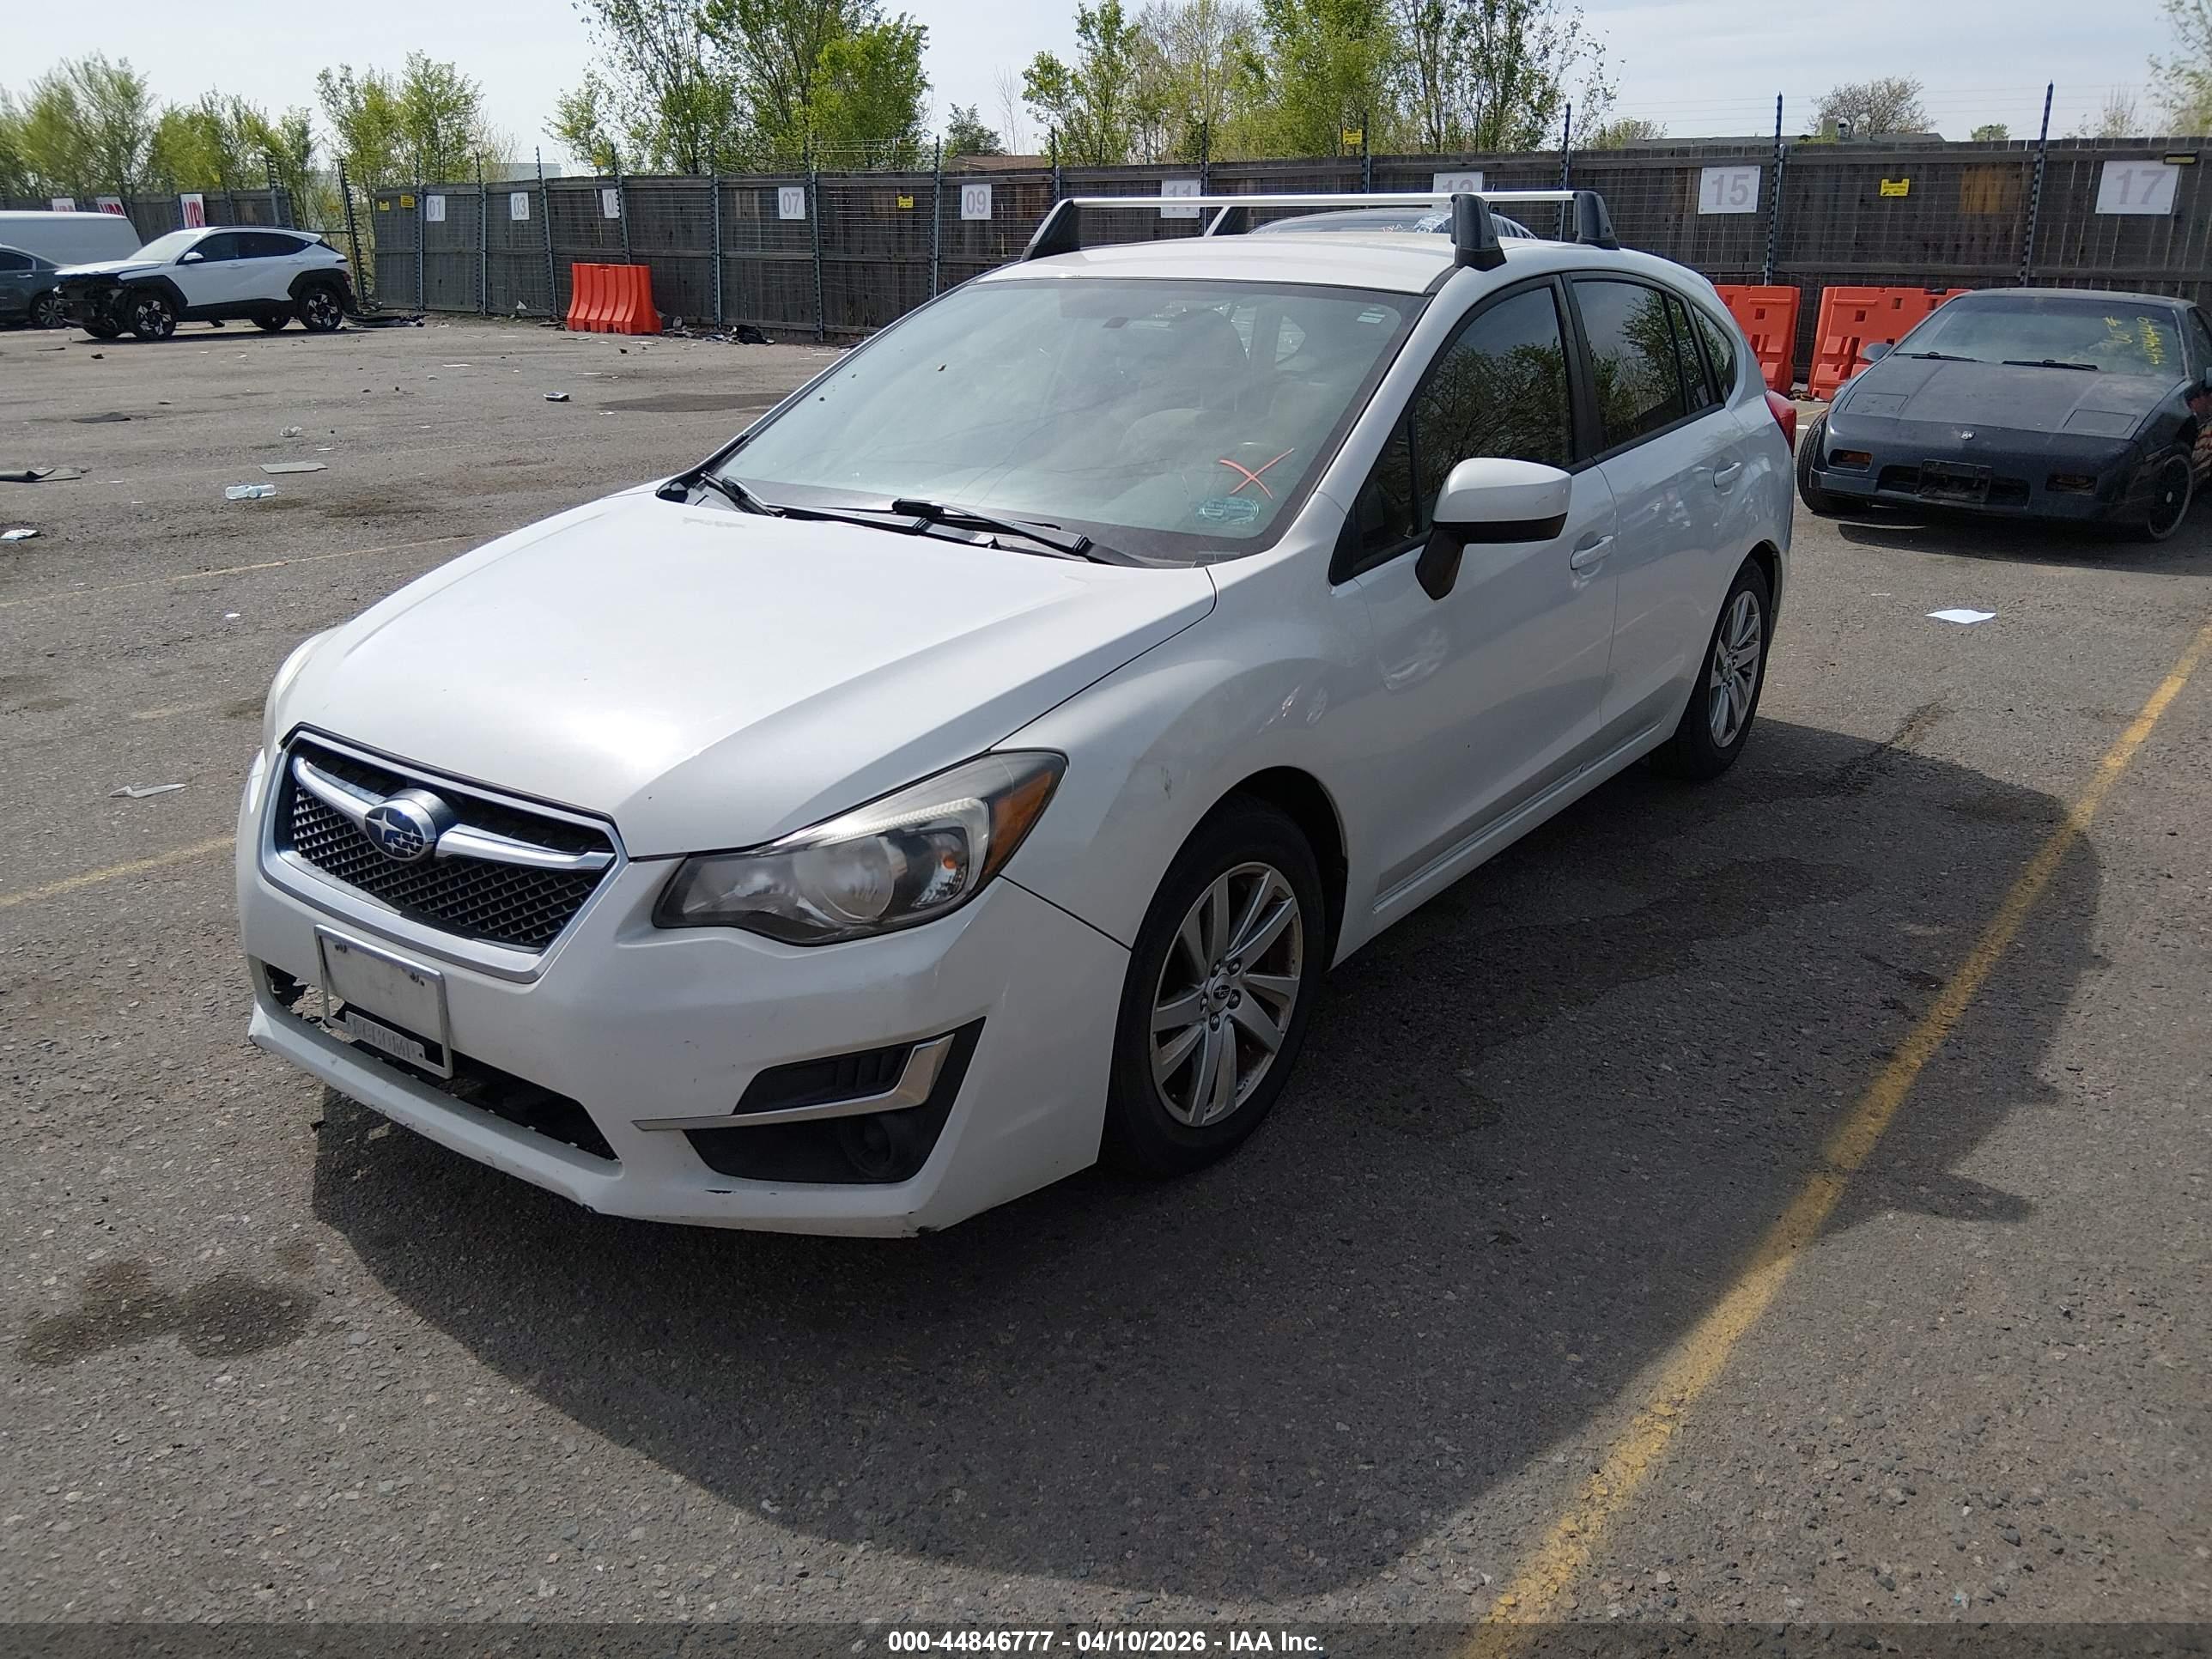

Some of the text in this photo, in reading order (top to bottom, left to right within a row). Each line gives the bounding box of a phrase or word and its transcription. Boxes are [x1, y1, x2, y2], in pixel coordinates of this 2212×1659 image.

[1711, 174, 1750, 206] 15
[2116, 168, 2167, 205] 17
[429, 198, 441, 217] 01
[514, 197, 526, 215] 03
[782, 191, 800, 214] 07
[966, 190, 987, 215] 09
